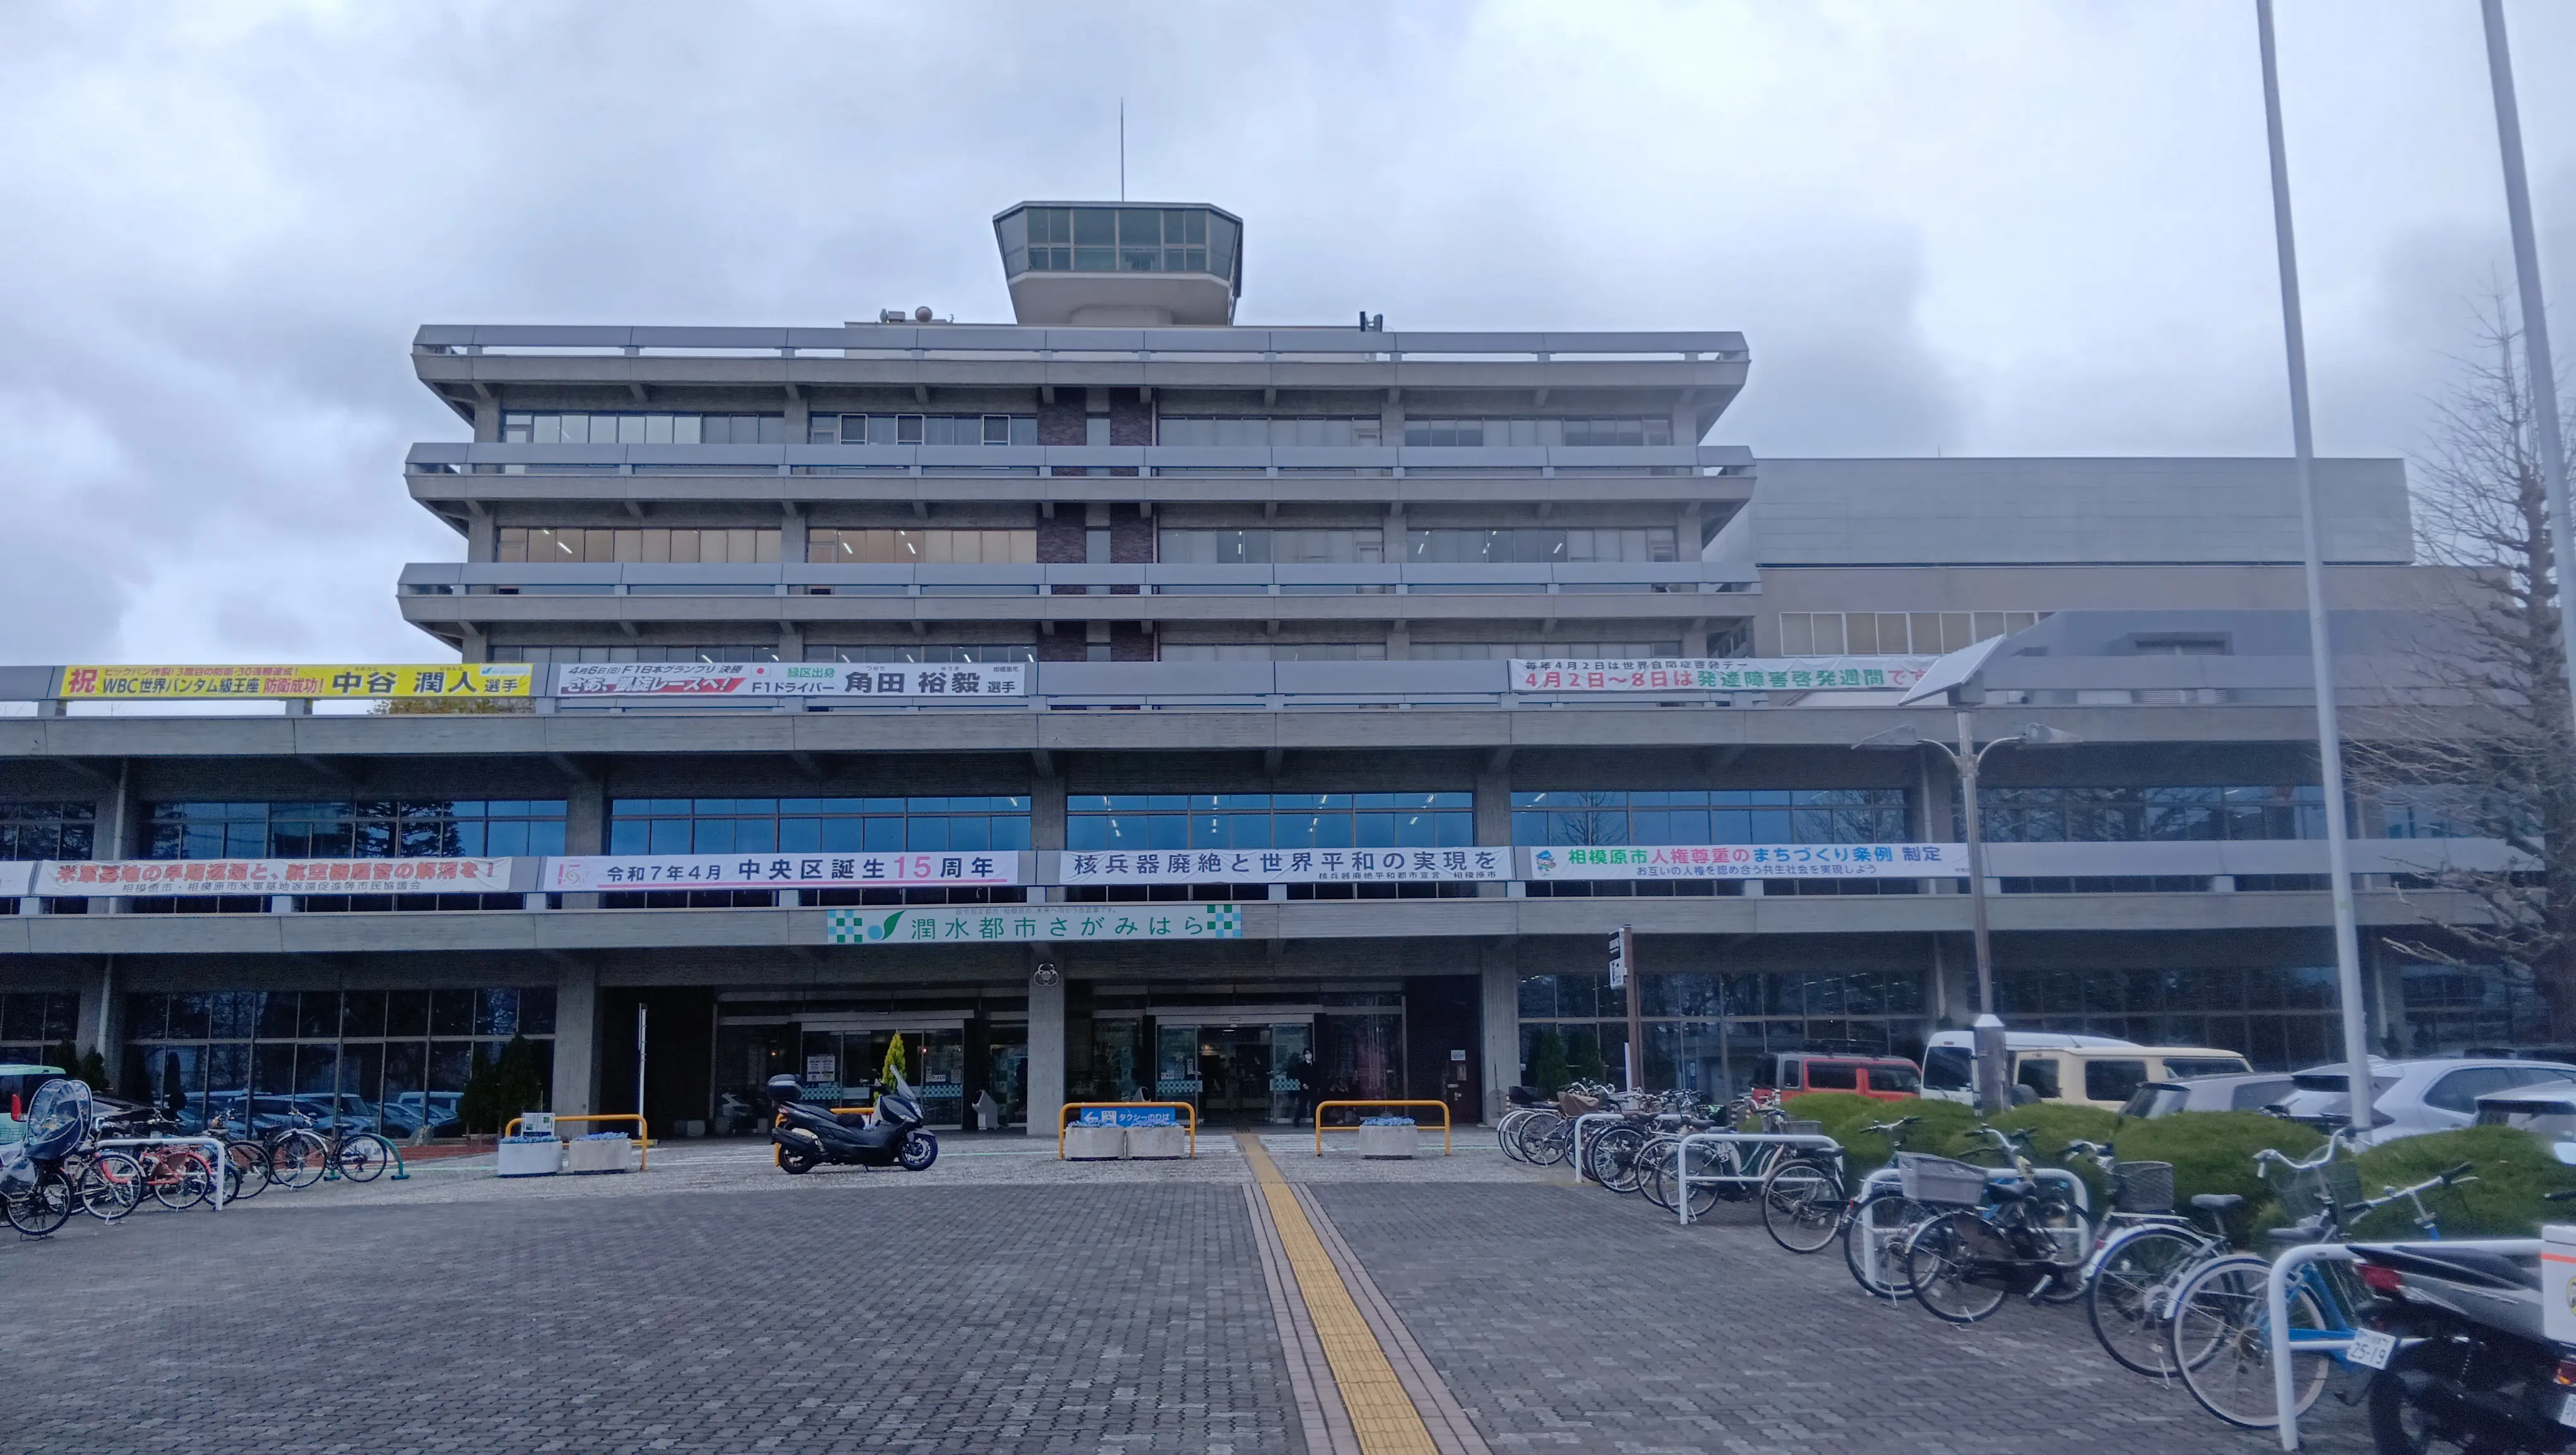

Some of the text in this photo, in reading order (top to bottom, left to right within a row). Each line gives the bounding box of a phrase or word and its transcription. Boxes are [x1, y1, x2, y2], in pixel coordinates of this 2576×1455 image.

[68, 668, 98, 693] 祝
[332, 671, 518, 694] 中谷 潤人 選手
[787, 667, 836, 678] 緑区出身
[845, 671, 1016, 693] 角田 裕毅 選手
[751, 681, 835, 693] F1ドライバー
[1074, 851, 1496, 875] 核兵器廃絶と世界平和の実現を
[1568, 846, 1942, 865] 相模原市人権尊重のまちづくり条例 制定
[607, 856, 994, 882] 令和7年4月 中央区誕生15周年
[1453, 871, 1496, 879] 相模原市
[1637, 864, 1876, 876] お互いの人権を認め合う共生社会を実現しよう
[911, 916, 1203, 940] 潤水都市さがみはら
